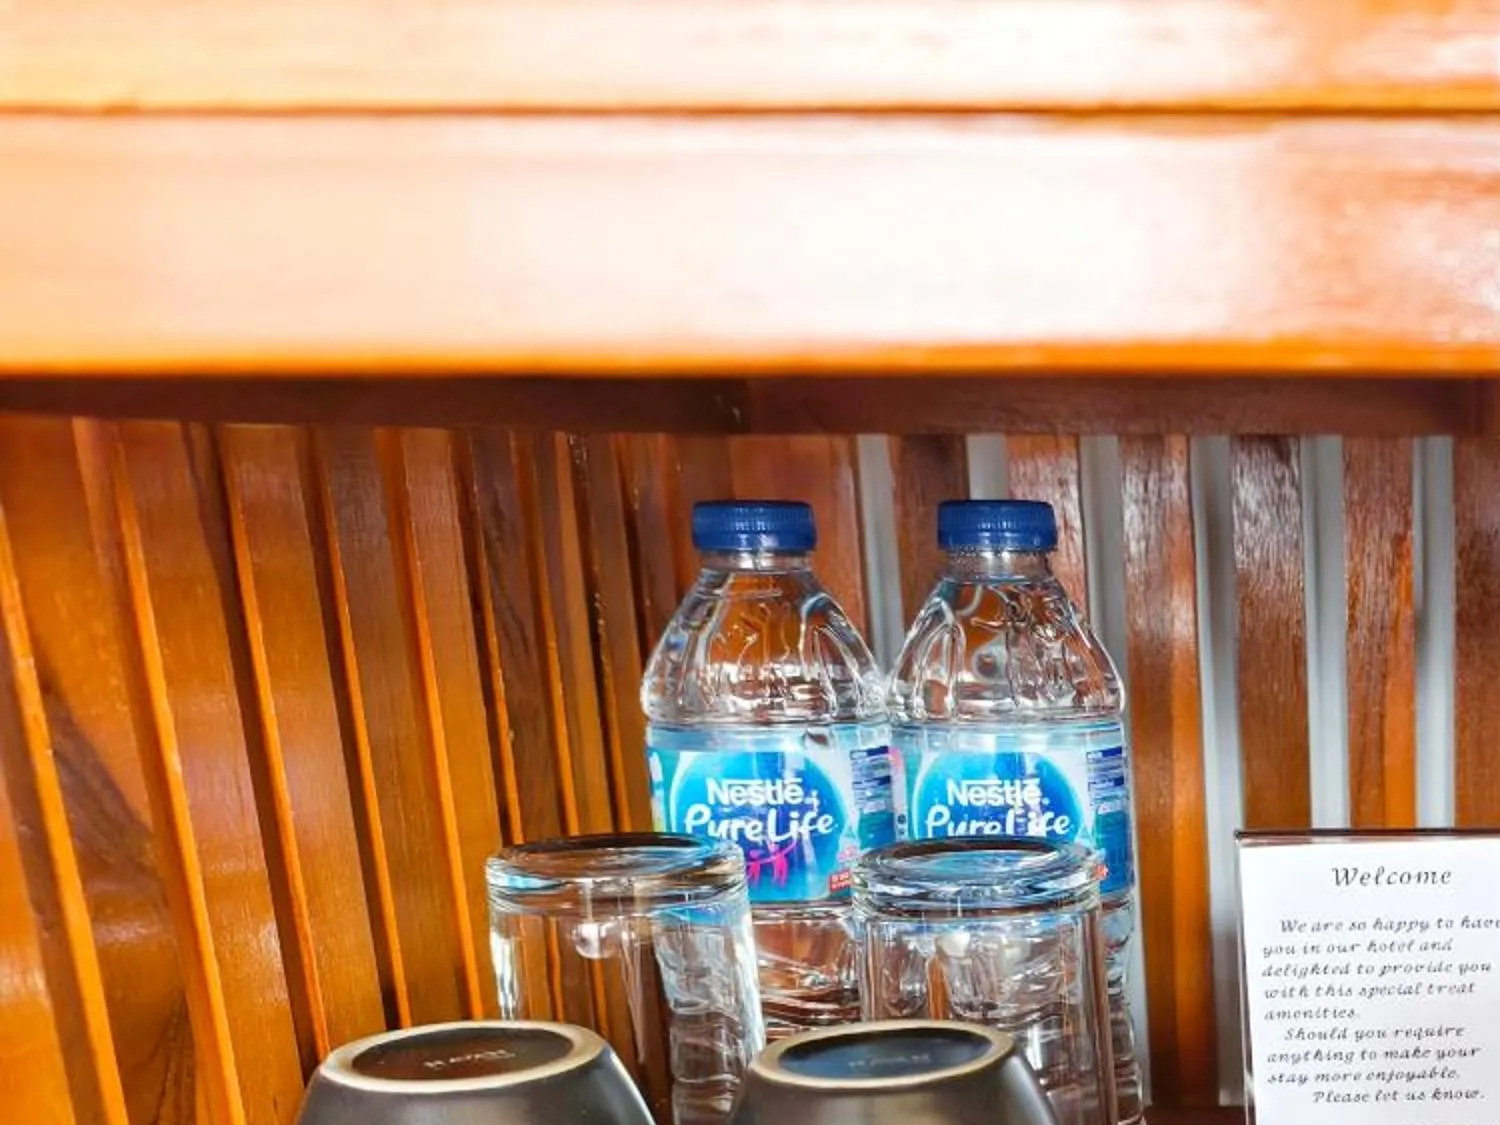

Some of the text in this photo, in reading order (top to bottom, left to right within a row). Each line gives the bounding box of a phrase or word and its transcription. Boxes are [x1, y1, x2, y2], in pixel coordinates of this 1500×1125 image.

[1331, 866, 1453, 887] Welcome
[1280, 919, 1308, 934] We
[1311, 919, 1343, 933] are
[1349, 919, 1367, 932] so
[1372, 917, 1430, 934] happy
[1437, 917, 1454, 930] to
[1262, 938, 1454, 958] you in our hotel and
[1261, 961, 1491, 979] delighted to provide you
[1263, 981, 1477, 1000] with this special treat
[1284, 1025, 1465, 1042] Should you require
[1267, 1046, 1482, 1064] anything to make your
[1267, 1070, 1308, 1085] stay
[1314, 1071, 1361, 1083] more
[1313, 1087, 1486, 1104] Please let us know.
